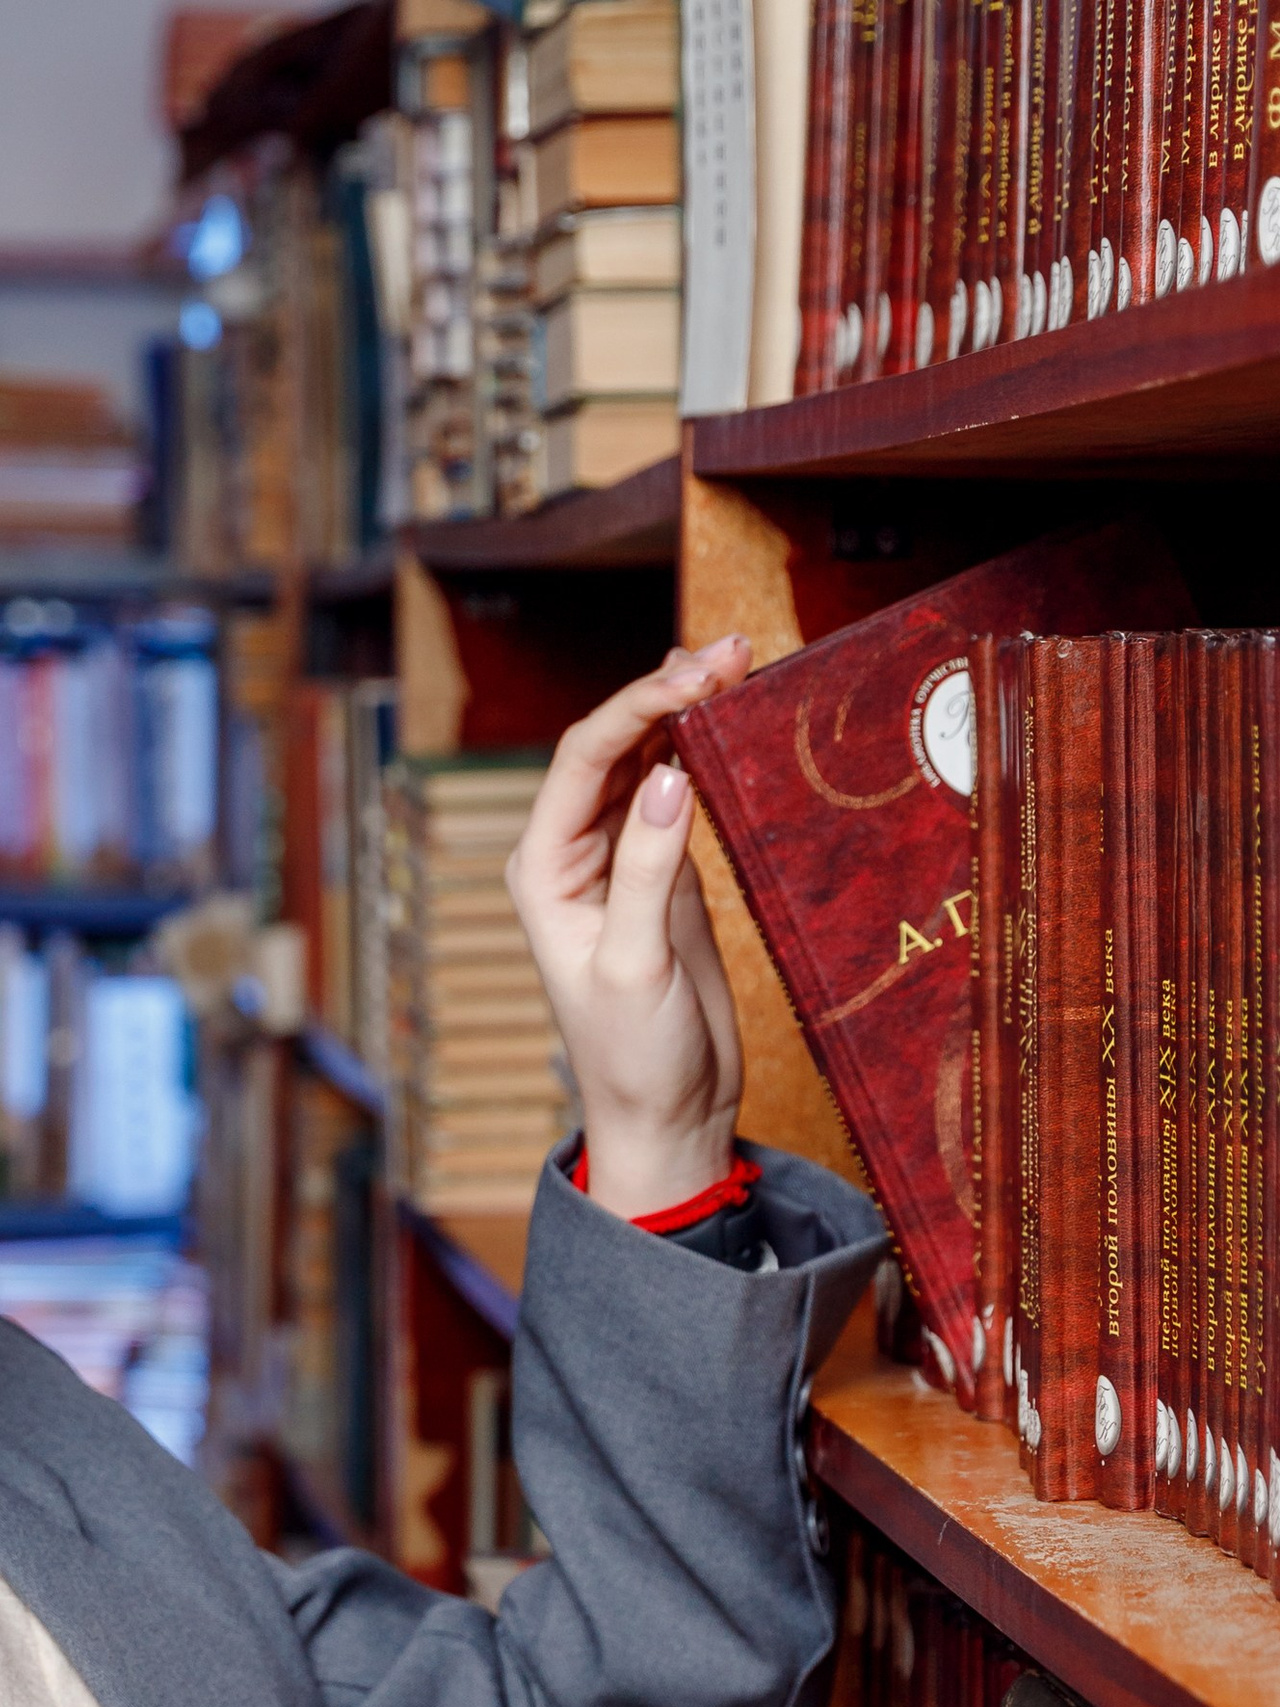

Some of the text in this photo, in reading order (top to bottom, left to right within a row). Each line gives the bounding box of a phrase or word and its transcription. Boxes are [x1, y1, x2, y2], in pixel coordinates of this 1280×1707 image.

[1092, 0, 1102, 100] Гонча
[1209, 28, 1223, 140] лирике
[1235, 18, 1248, 132] лирике
[1251, 724, 1260, 793] века
[1254, 874, 1263, 1029] половины
[1162, 979, 1170, 1037] века
[1160, 1046, 1170, 1109] XIX
[1223, 1069, 1232, 1136] XIX
[1102, 928, 1123, 1337] второй половины XX века
[1162, 1118, 1170, 1249] половины
[1240, 1144, 1248, 1285] половины
[1170, 1263, 1181, 1357] первой
[1207, 1277, 1218, 1371] второй
[1224, 1290, 1235, 1386] второй
[1240, 1292, 1251, 1389] второй
[1256, 1270, 1267, 1396] Русская
